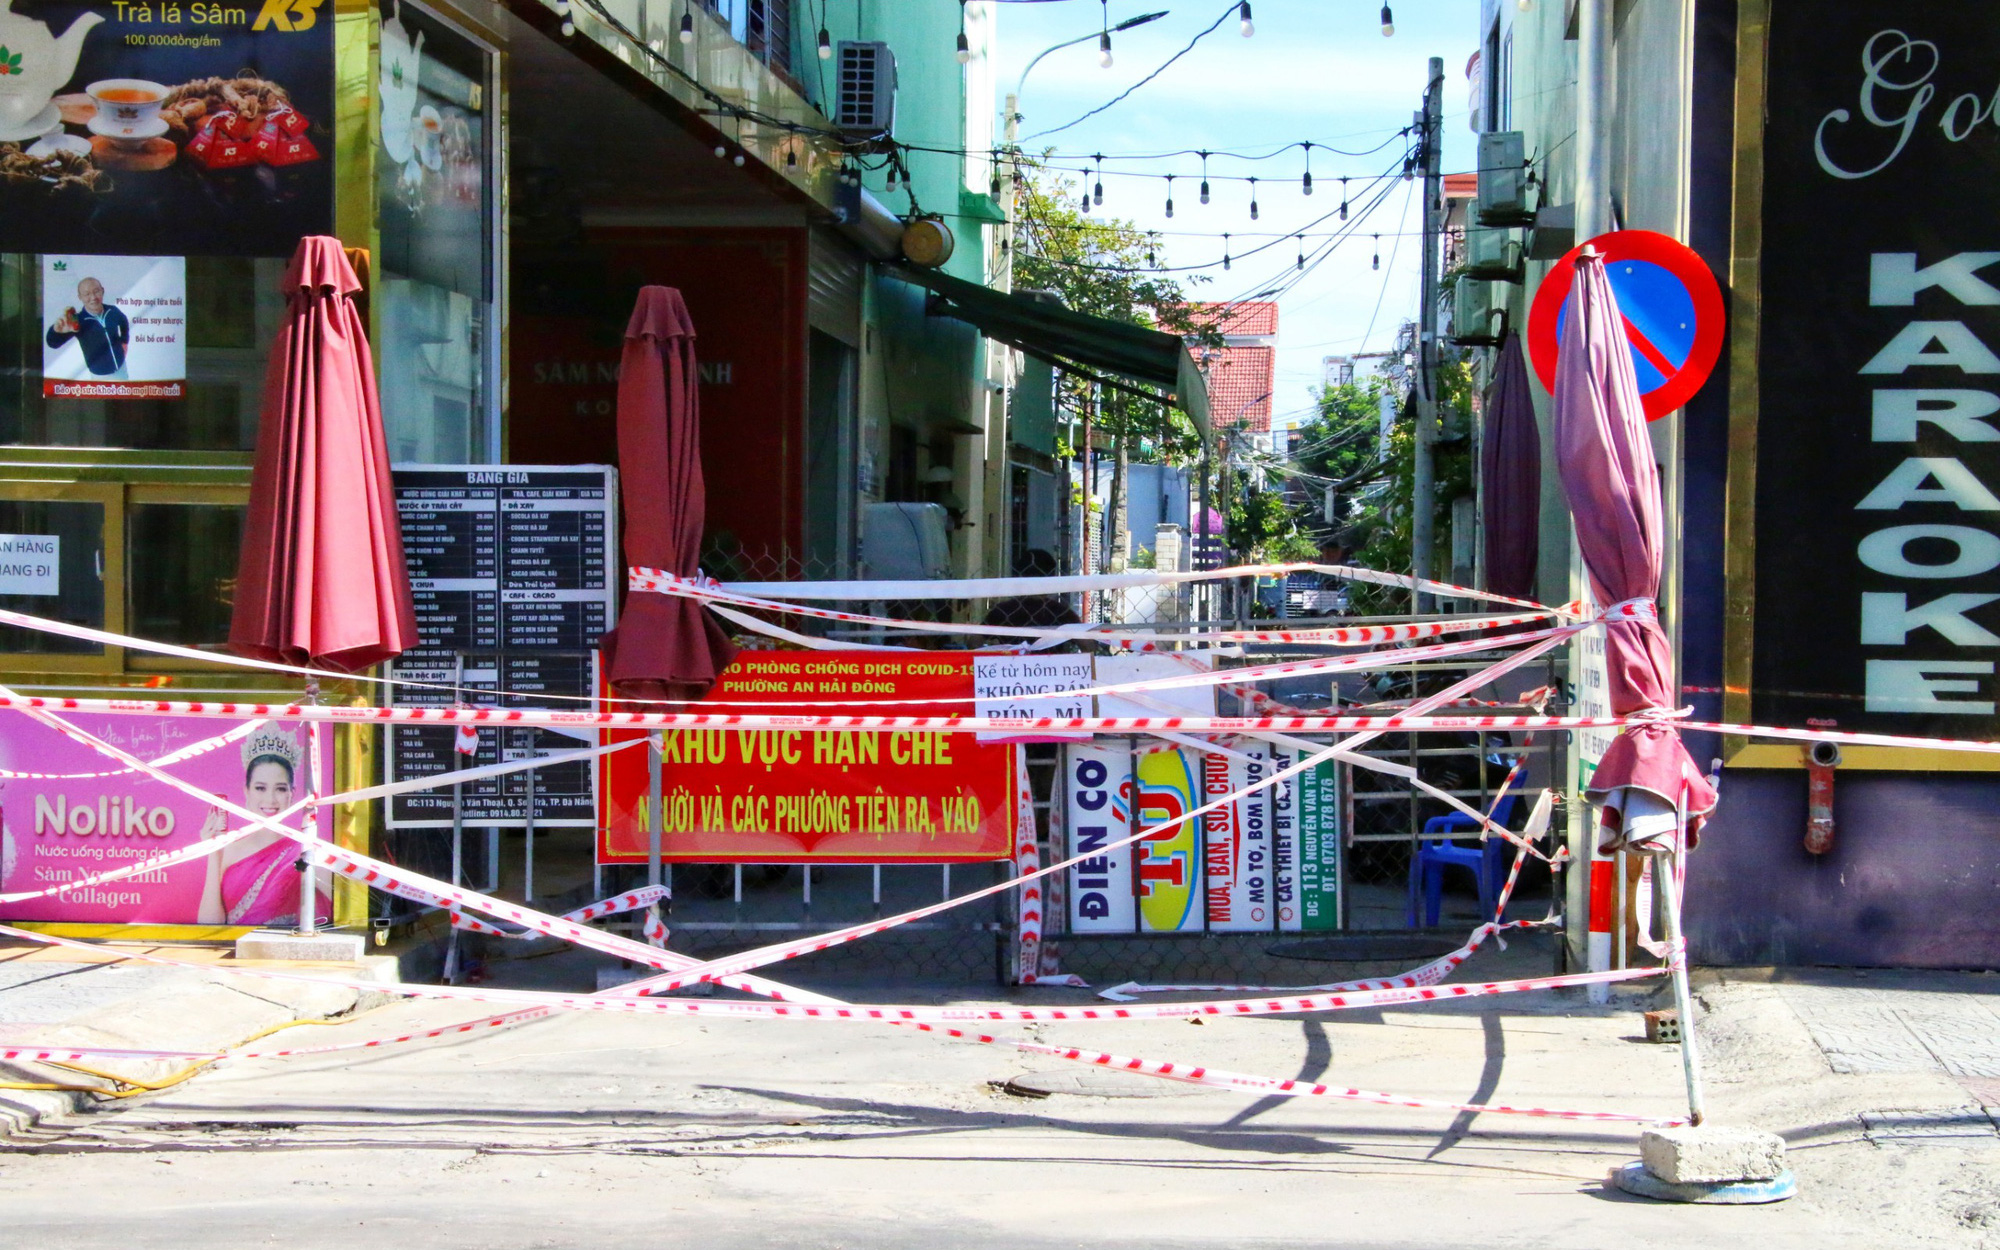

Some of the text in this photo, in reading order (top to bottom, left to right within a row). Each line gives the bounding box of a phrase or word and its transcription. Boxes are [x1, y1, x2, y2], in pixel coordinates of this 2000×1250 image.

[112, 1, 153, 24] Trà
[161, 1, 181, 24] lá
[190, 2, 245, 25] Sâm
[1814, 28, 2000, 180] Go
[1854, 252, 2000, 714] KARAOKE
[16, 539, 54, 554] HÀNG
[0, 564, 50, 577] ANG ĐI
[746, 660, 801, 675] PHÒNG
[805, 659, 860, 675] CHỐNG
[864, 663, 901, 678] DỊCH
[977, 663, 1091, 679] Kể từ hôm nay
[723, 677, 896, 693] PHƯỜNG AN HẢI ĐÔNG
[661, 729, 726, 764] KHU
[813, 729, 879, 773] HẠN
[1303, 788, 1317, 812] VĂN
[1320, 777, 1335, 802] 676
[34, 793, 175, 837] Noliko
[638, 784, 695, 833] NƯỜI
[700, 785, 725, 833] VÀ
[731, 784, 769, 833] CÁC
[775, 788, 850, 833] PHƯƠNG
[855, 785, 900, 841] TIỆN
[905, 796, 936, 841] RA,
[941, 785, 980, 833] VÀO
[1247, 803, 1264, 840] BƠM
[1321, 805, 1335, 830] 878
[1071, 757, 1116, 921] ĐIỆN CƠ
[1301, 812, 1317, 861] NGUYỄN
[1321, 832, 1335, 865] 0703
[34, 844, 69, 857] Nước
[71, 843, 104, 861] uống
[106, 845, 148, 862] dưỡng
[1248, 844, 1267, 872] TƠ,
[34, 864, 72, 882] Sâm
[1302, 863, 1318, 891] 113
[58, 887, 142, 909] Collagen
[1246, 876, 1266, 904] MÔ
